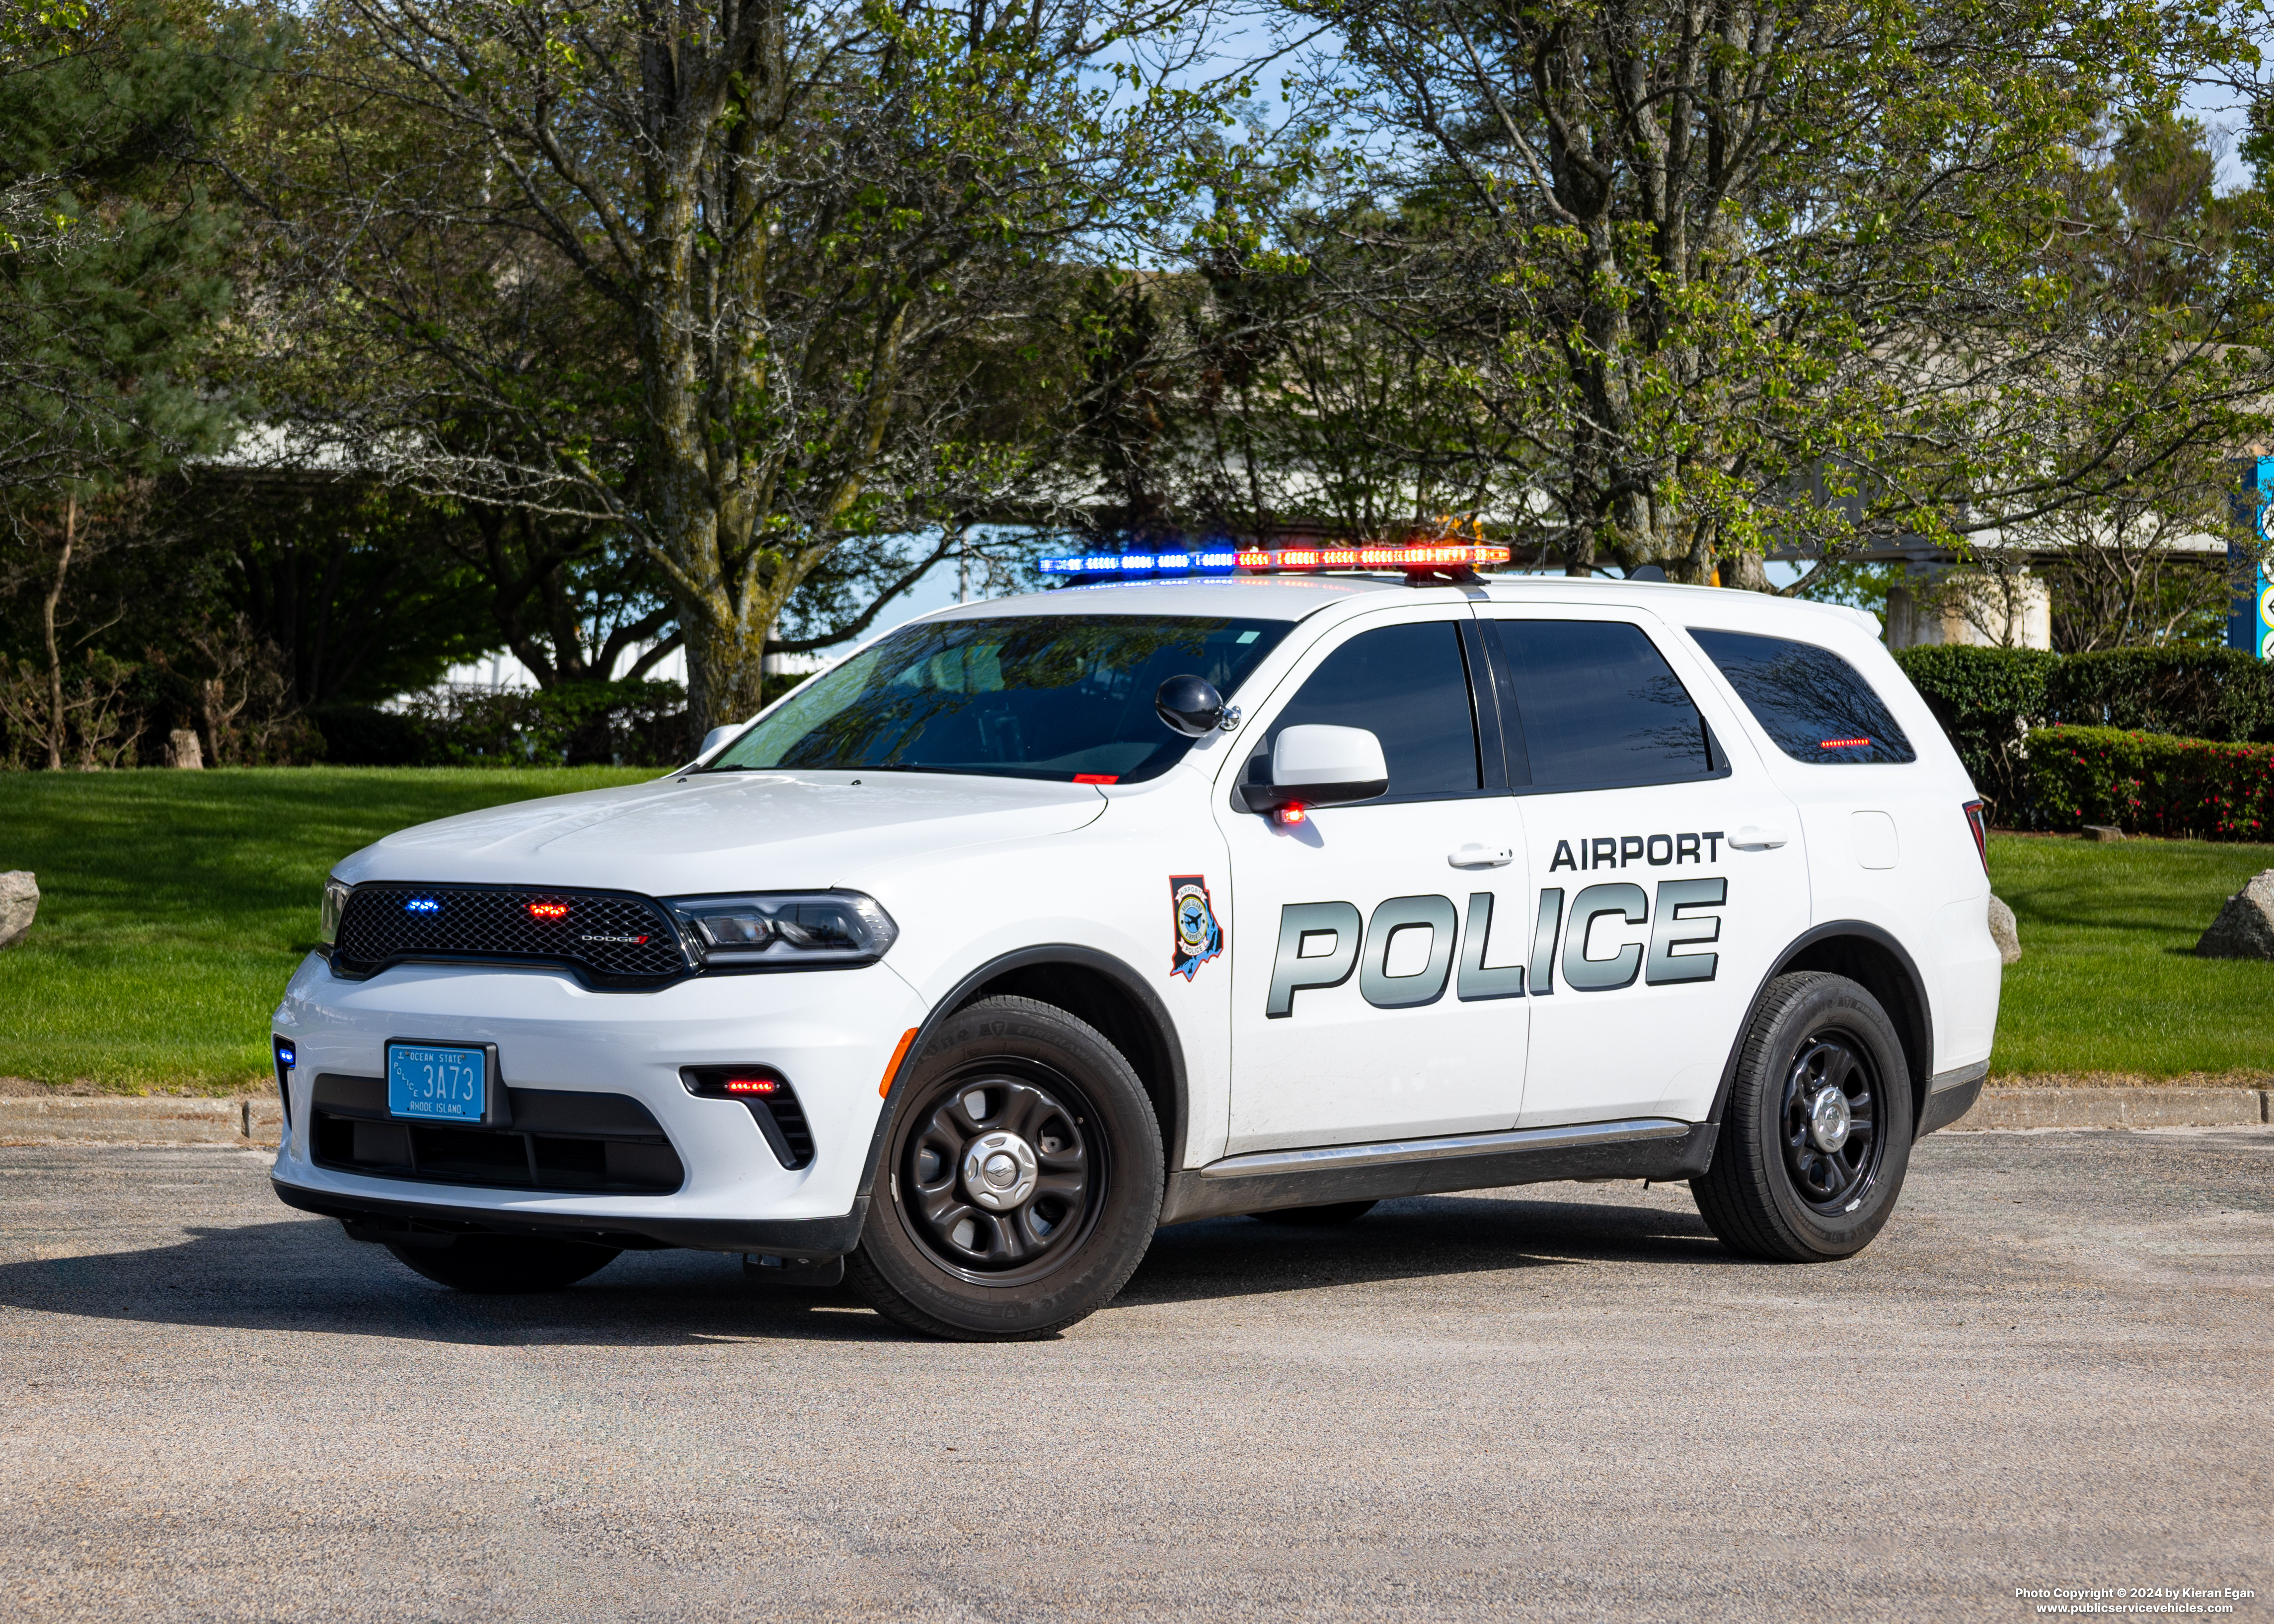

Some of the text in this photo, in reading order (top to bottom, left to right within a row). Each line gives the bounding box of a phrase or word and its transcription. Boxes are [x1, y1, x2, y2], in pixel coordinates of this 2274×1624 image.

[1549, 831, 1724, 873] AIRPORT
[1180, 886, 1201, 896] AIRPORT
[1181, 900, 1203, 912] RHODE ISLAND
[1185, 931, 1202, 941] AIRPORTS
[1185, 945, 1203, 955] POLICE
[1266, 877, 1728, 1020] POLICE
[410, 1052, 462, 1064] OCEAN STATE
[1016, 1024, 1098, 1071] FIREHAWK
[393, 1062, 418, 1098] POLICE
[423, 1064, 473, 1101] 3A73
[410, 1101, 462, 1114] RHODE ISLAND
[908, 1270, 992, 1315] FIREHAWK
